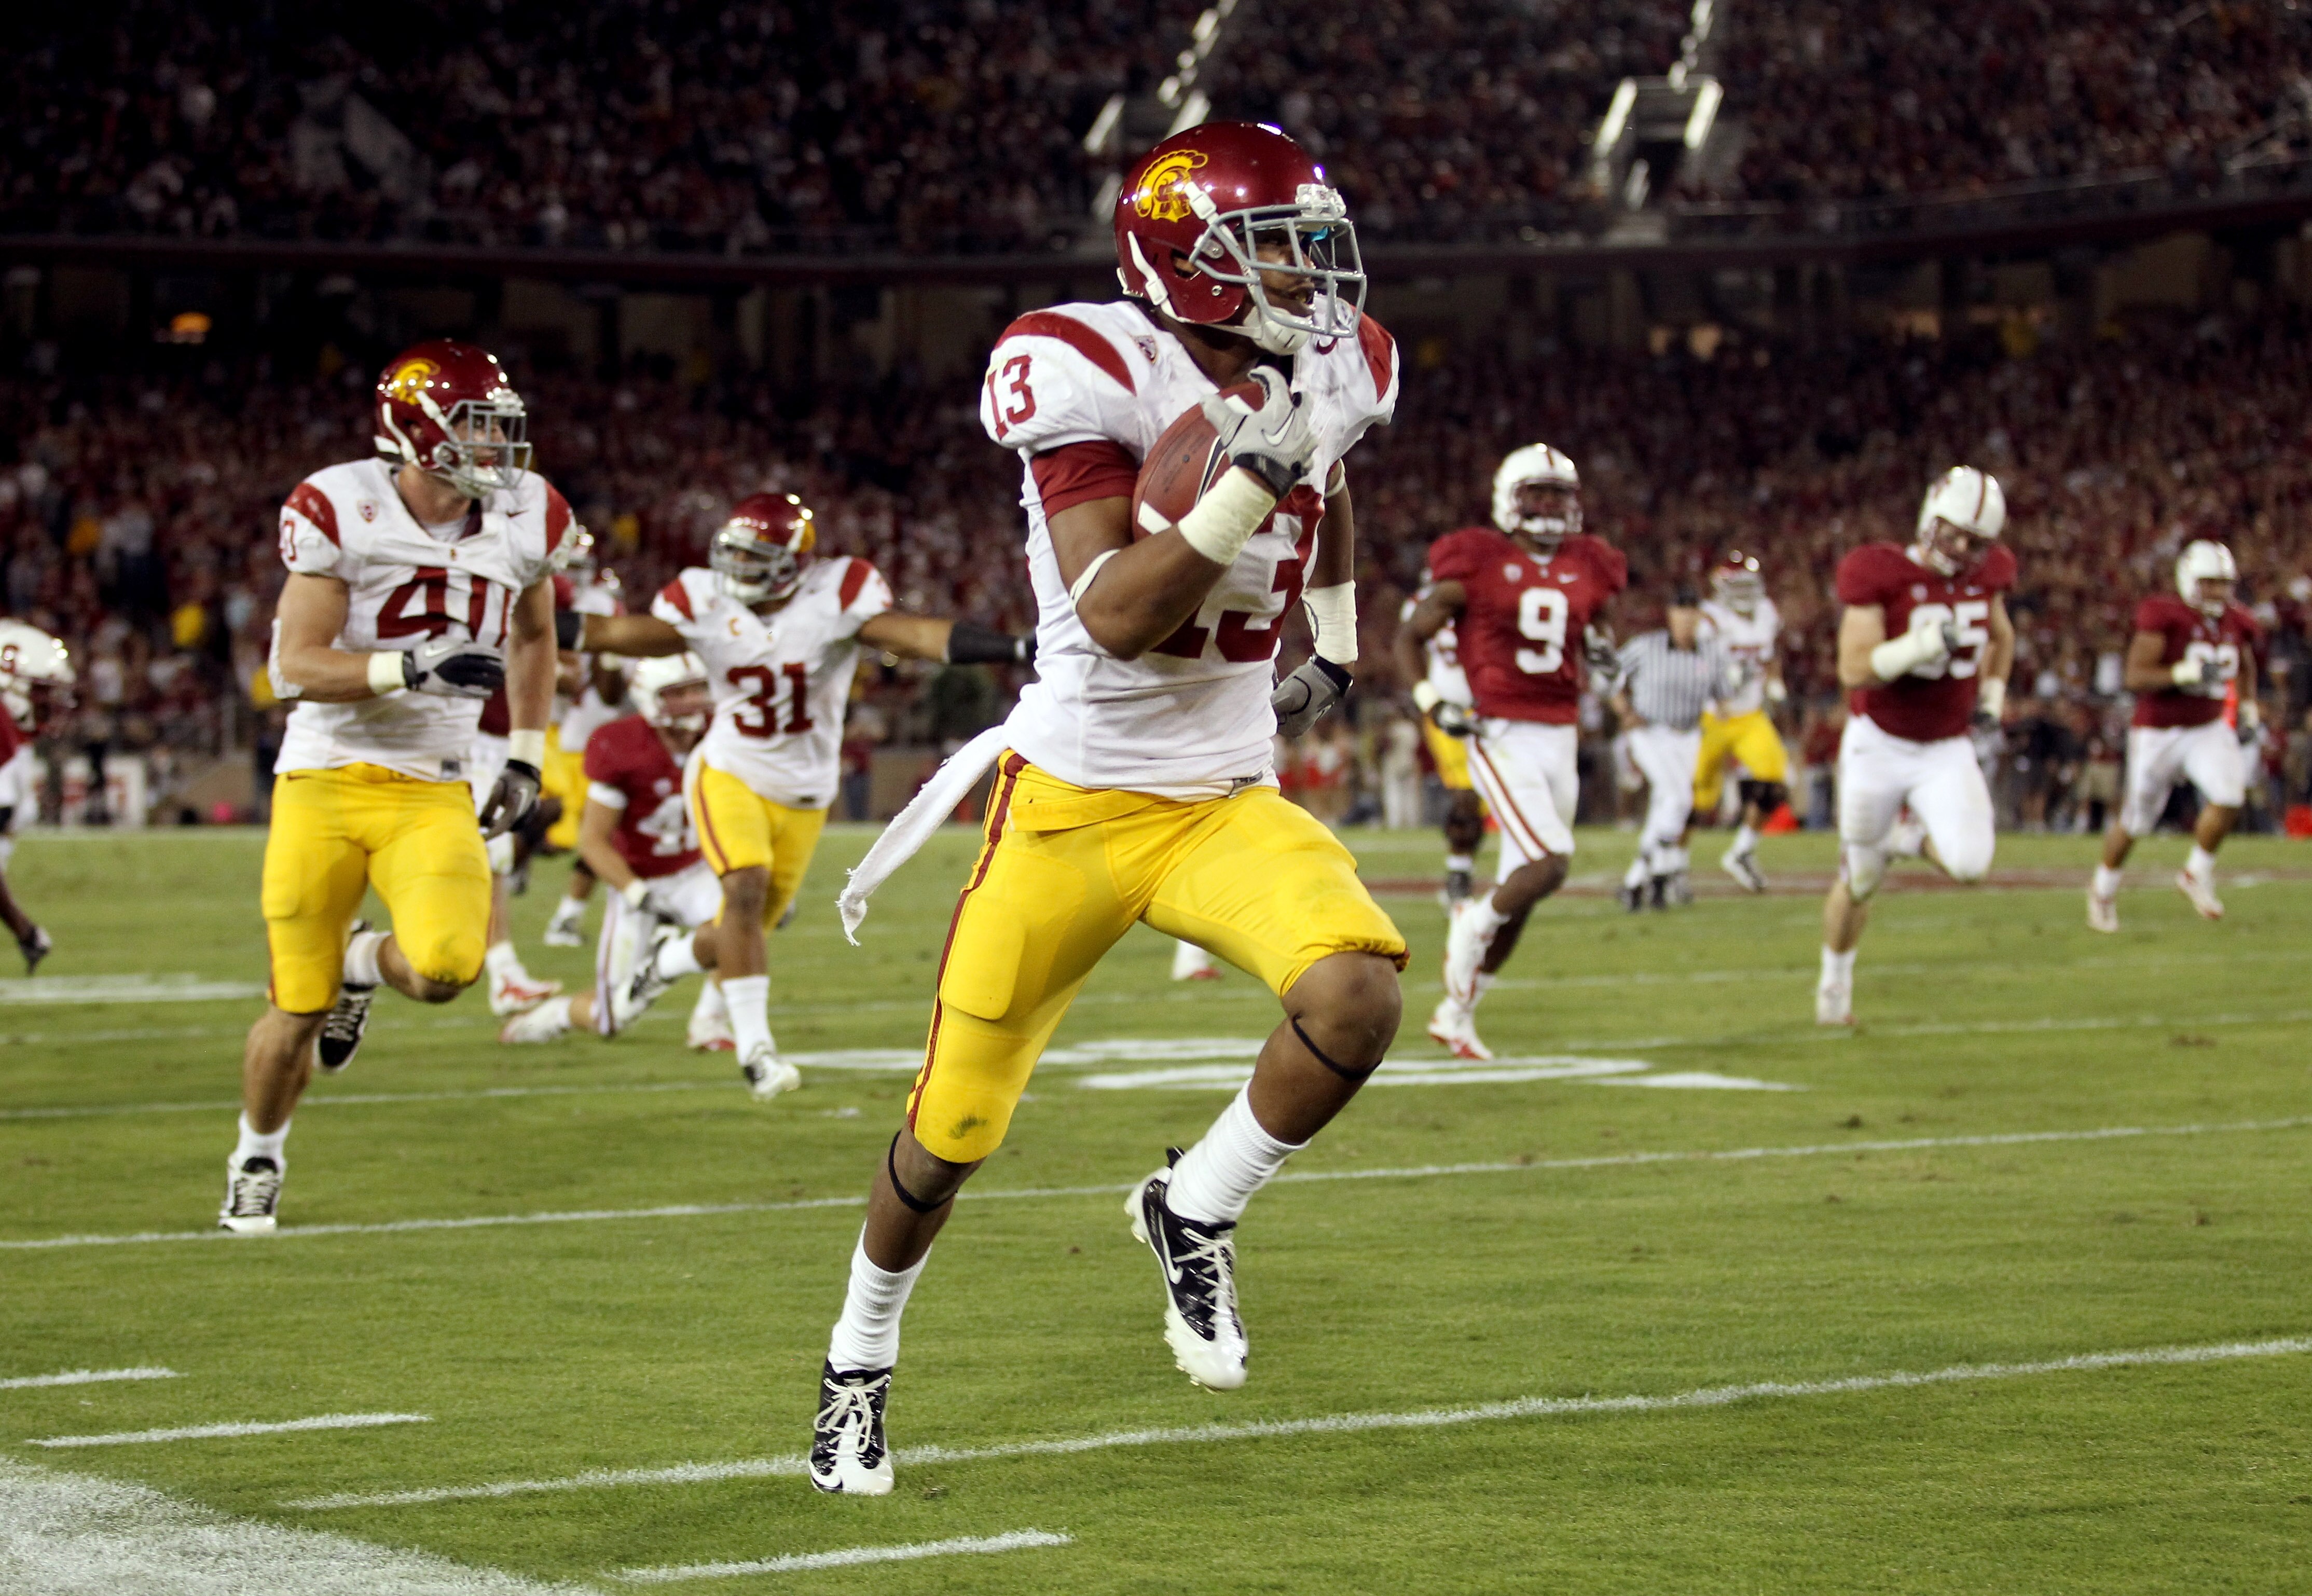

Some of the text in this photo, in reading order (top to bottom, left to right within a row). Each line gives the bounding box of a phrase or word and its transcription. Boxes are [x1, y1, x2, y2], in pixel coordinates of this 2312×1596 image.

[987, 355, 1036, 441] 13
[1149, 484, 1325, 662] 3
[1516, 587, 1568, 673] 9
[726, 662, 814, 738] 31
